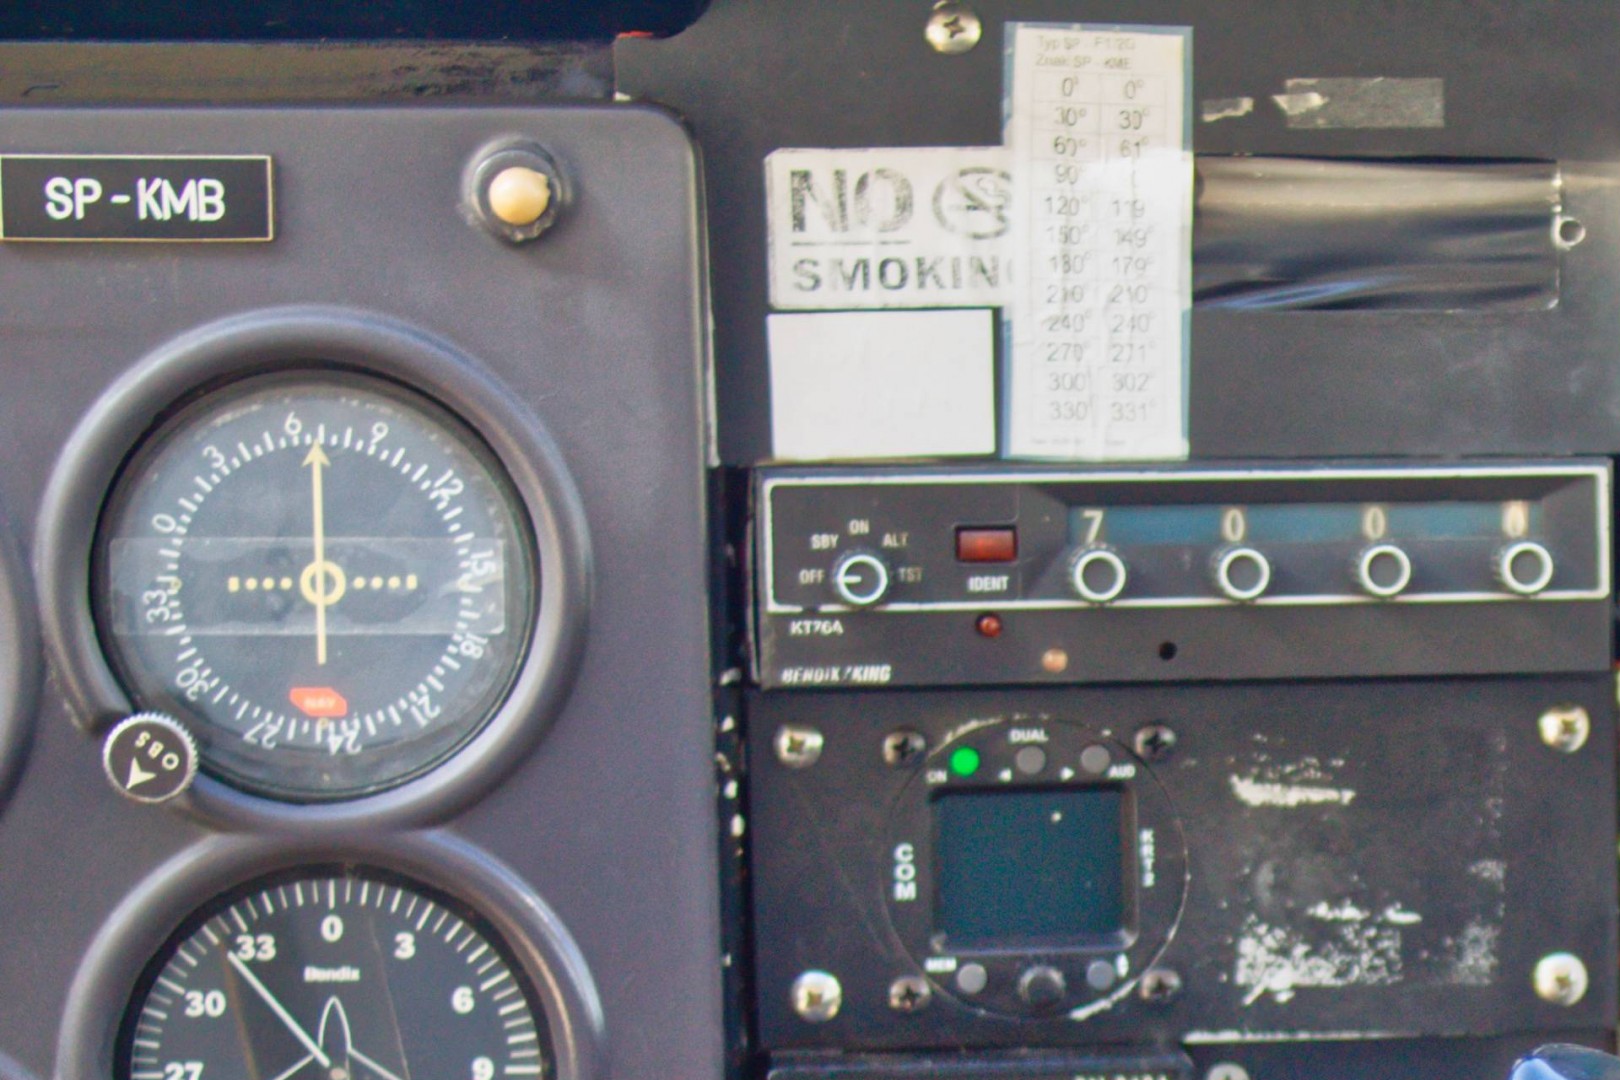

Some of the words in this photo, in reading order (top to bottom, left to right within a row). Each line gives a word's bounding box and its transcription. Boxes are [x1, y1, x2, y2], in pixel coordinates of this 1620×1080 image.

[789, 168, 914, 233] NO
[793, 255, 1012, 291] SMOKIN
[284, 412, 303, 435] 6
[371, 422, 389, 444] 9
[203, 445, 226, 469] 3
[434, 469, 465, 499] 12
[151, 513, 177, 534] 0
[850, 519, 870, 534] ON
[1082, 509, 1103, 543] 7
[1223, 509, 1246, 542] 0
[1362, 507, 1386, 540] 0
[811, 534, 839, 550] SBY
[882, 533, 909, 547] ALT
[799, 569, 826, 584] OFF
[967, 576, 1009, 591] IDENT
[143, 590, 171, 622] 33
[789, 620, 844, 635] KT76A
[177, 667, 211, 702] 30
[410, 694, 441, 727] 21
[243, 720, 277, 749] 27
[1008, 729, 1049, 743] DUAL
[135, 731, 179, 770] OBS
[926, 770, 947, 783] ON
[894, 843, 916, 900] COM
[322, 916, 343, 941] 0
[236, 934, 276, 961] 33
[395, 933, 415, 959] 3
[304, 966, 360, 983] Bendix
[185, 991, 226, 1016] 30
[452, 988, 474, 1013] 6
